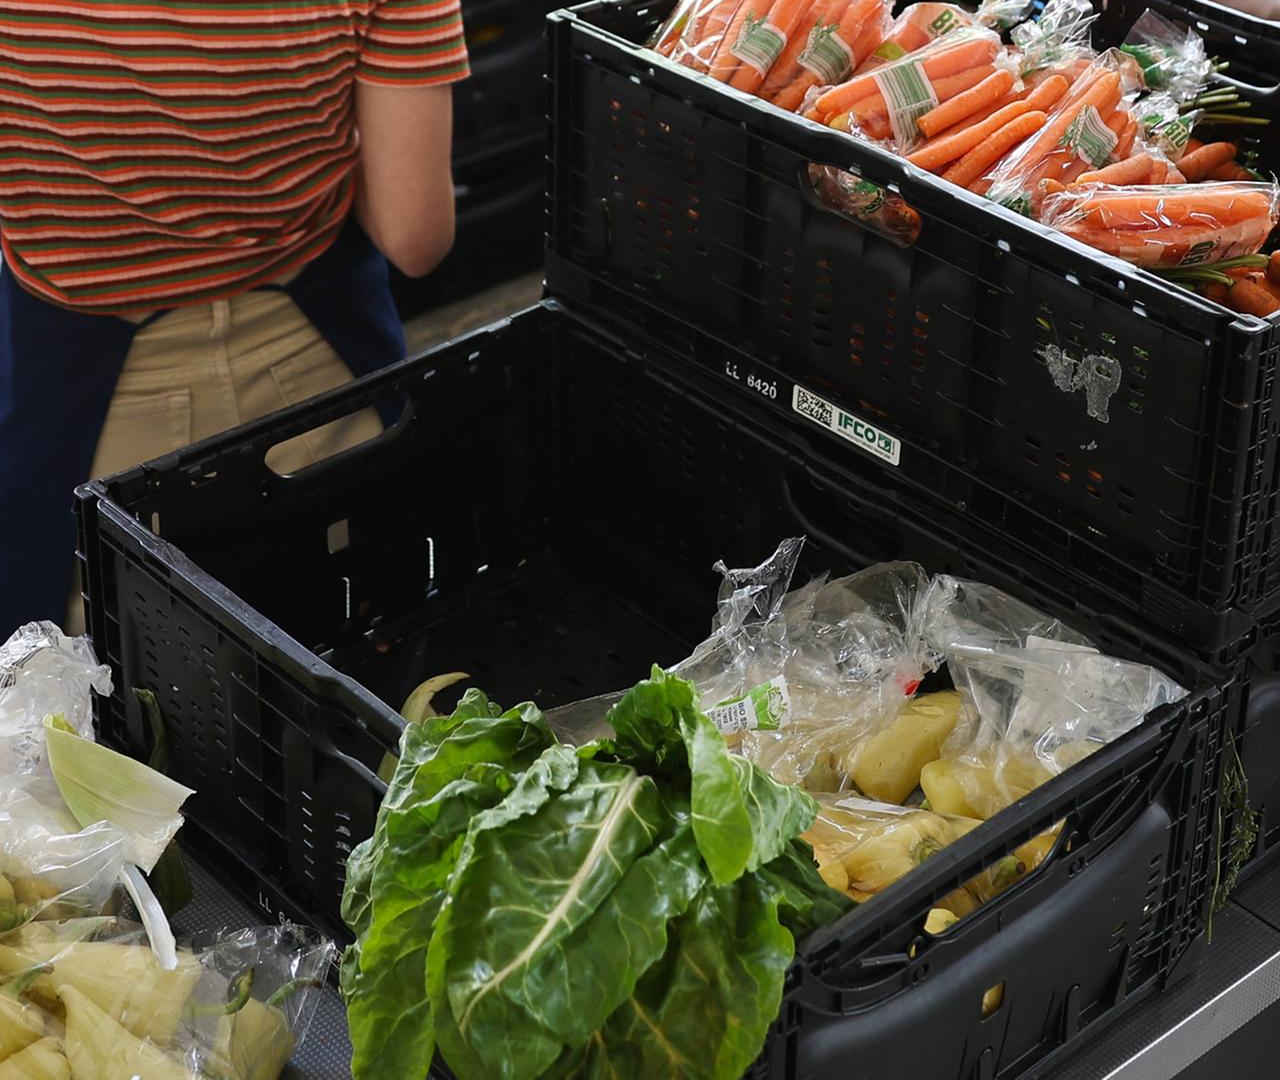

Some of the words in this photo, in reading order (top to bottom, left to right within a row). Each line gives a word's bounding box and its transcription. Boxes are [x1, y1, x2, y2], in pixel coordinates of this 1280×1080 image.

[931, 9, 959, 35] Bi
[725, 361, 740, 380] LL
[747, 374, 778, 400] 6420
[838, 412, 877, 444] IFCO
[258, 892, 272, 914] LL
